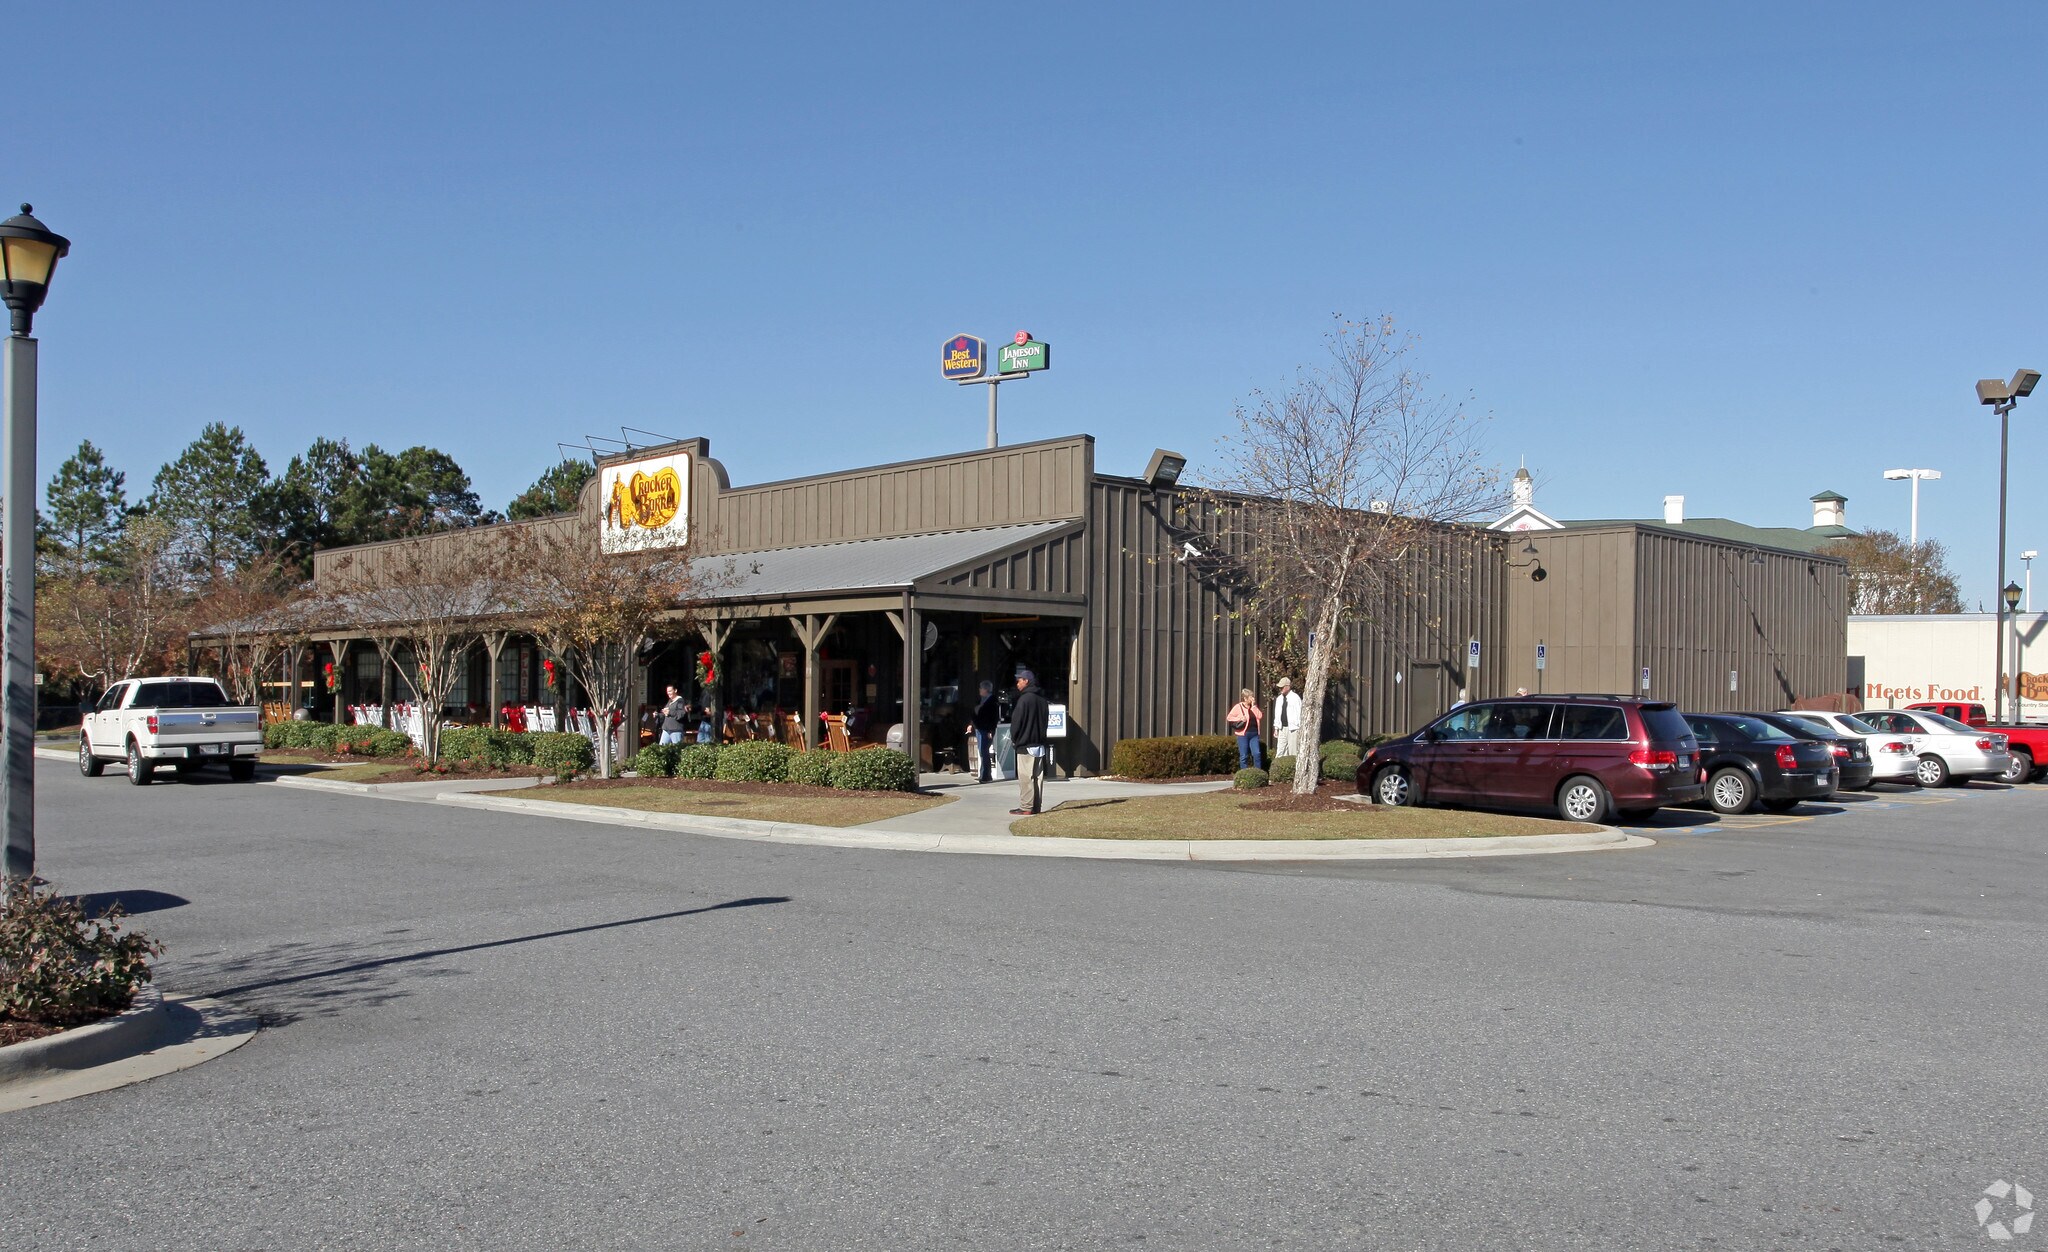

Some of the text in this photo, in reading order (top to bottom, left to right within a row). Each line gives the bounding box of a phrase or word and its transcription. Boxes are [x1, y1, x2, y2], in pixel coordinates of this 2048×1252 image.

[951, 349, 970, 361] Best
[1002, 346, 1040, 362] JAMESON
[944, 358, 978, 370] Western
[1012, 358, 1029, 369] INN
[1866, 683, 1921, 700] Meets
